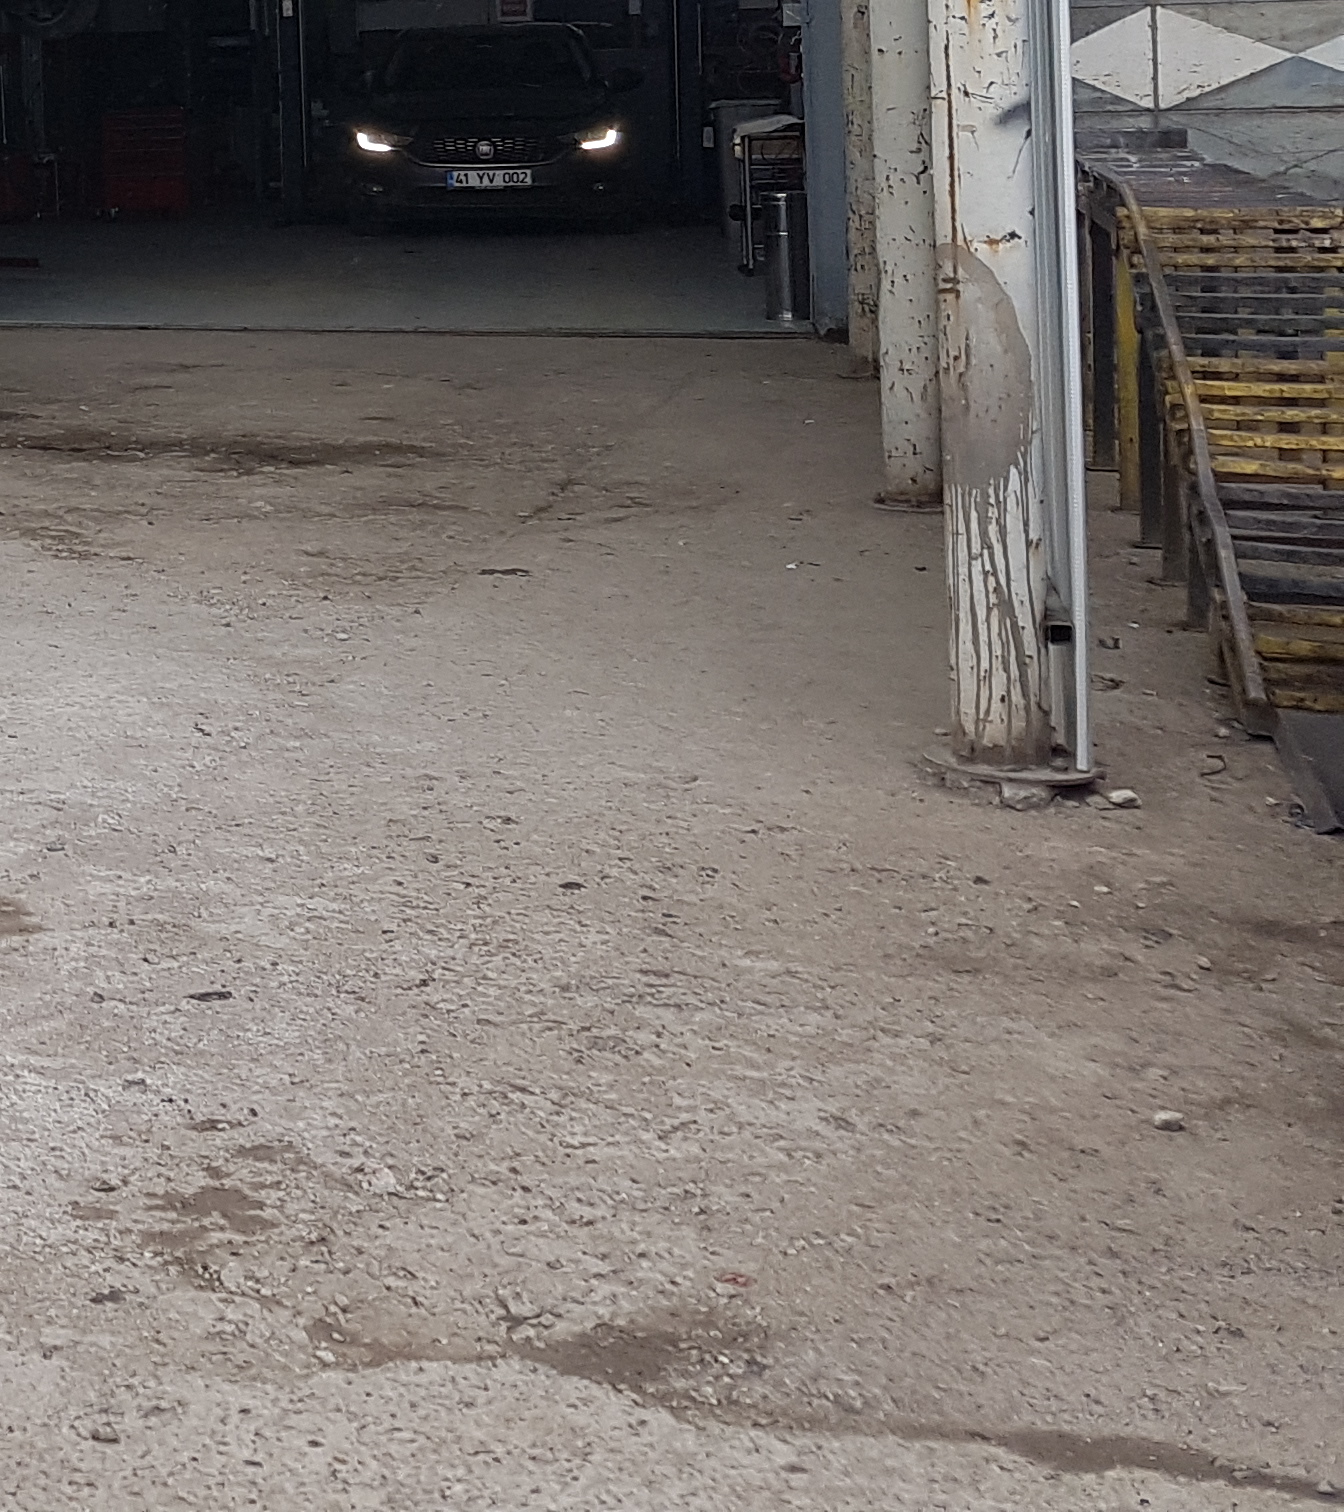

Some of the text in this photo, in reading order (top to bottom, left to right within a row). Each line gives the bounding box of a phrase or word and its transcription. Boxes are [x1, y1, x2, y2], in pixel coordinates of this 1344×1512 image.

[455, 171, 529, 185] 41 YV 002
